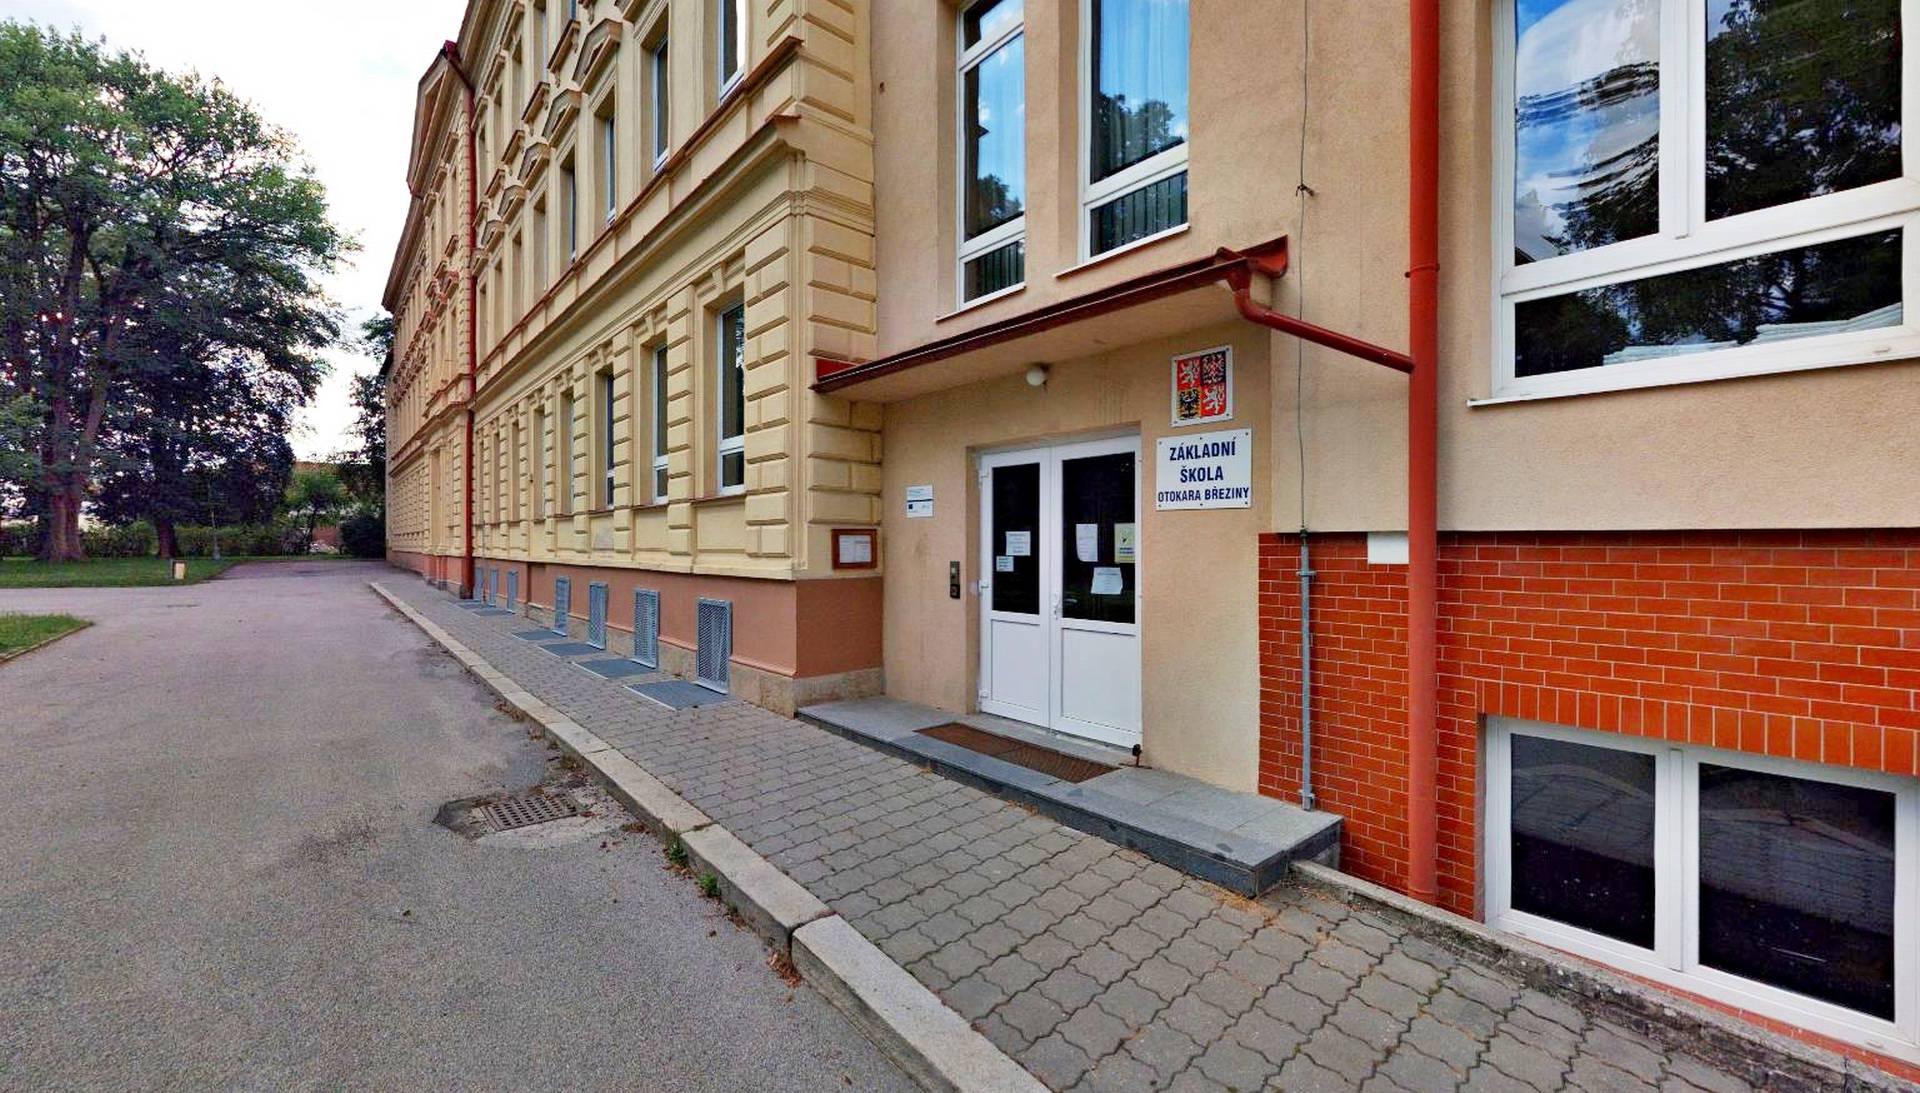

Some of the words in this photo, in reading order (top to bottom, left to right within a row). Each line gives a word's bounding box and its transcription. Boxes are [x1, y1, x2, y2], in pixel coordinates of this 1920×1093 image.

[1169, 436, 1237, 461] ZÁKLADNÍ
[1180, 465, 1224, 483] ŠKOLA
[1158, 489, 1201, 502] OTOKARA
[1204, 485, 1250, 500] BŘEZINY
